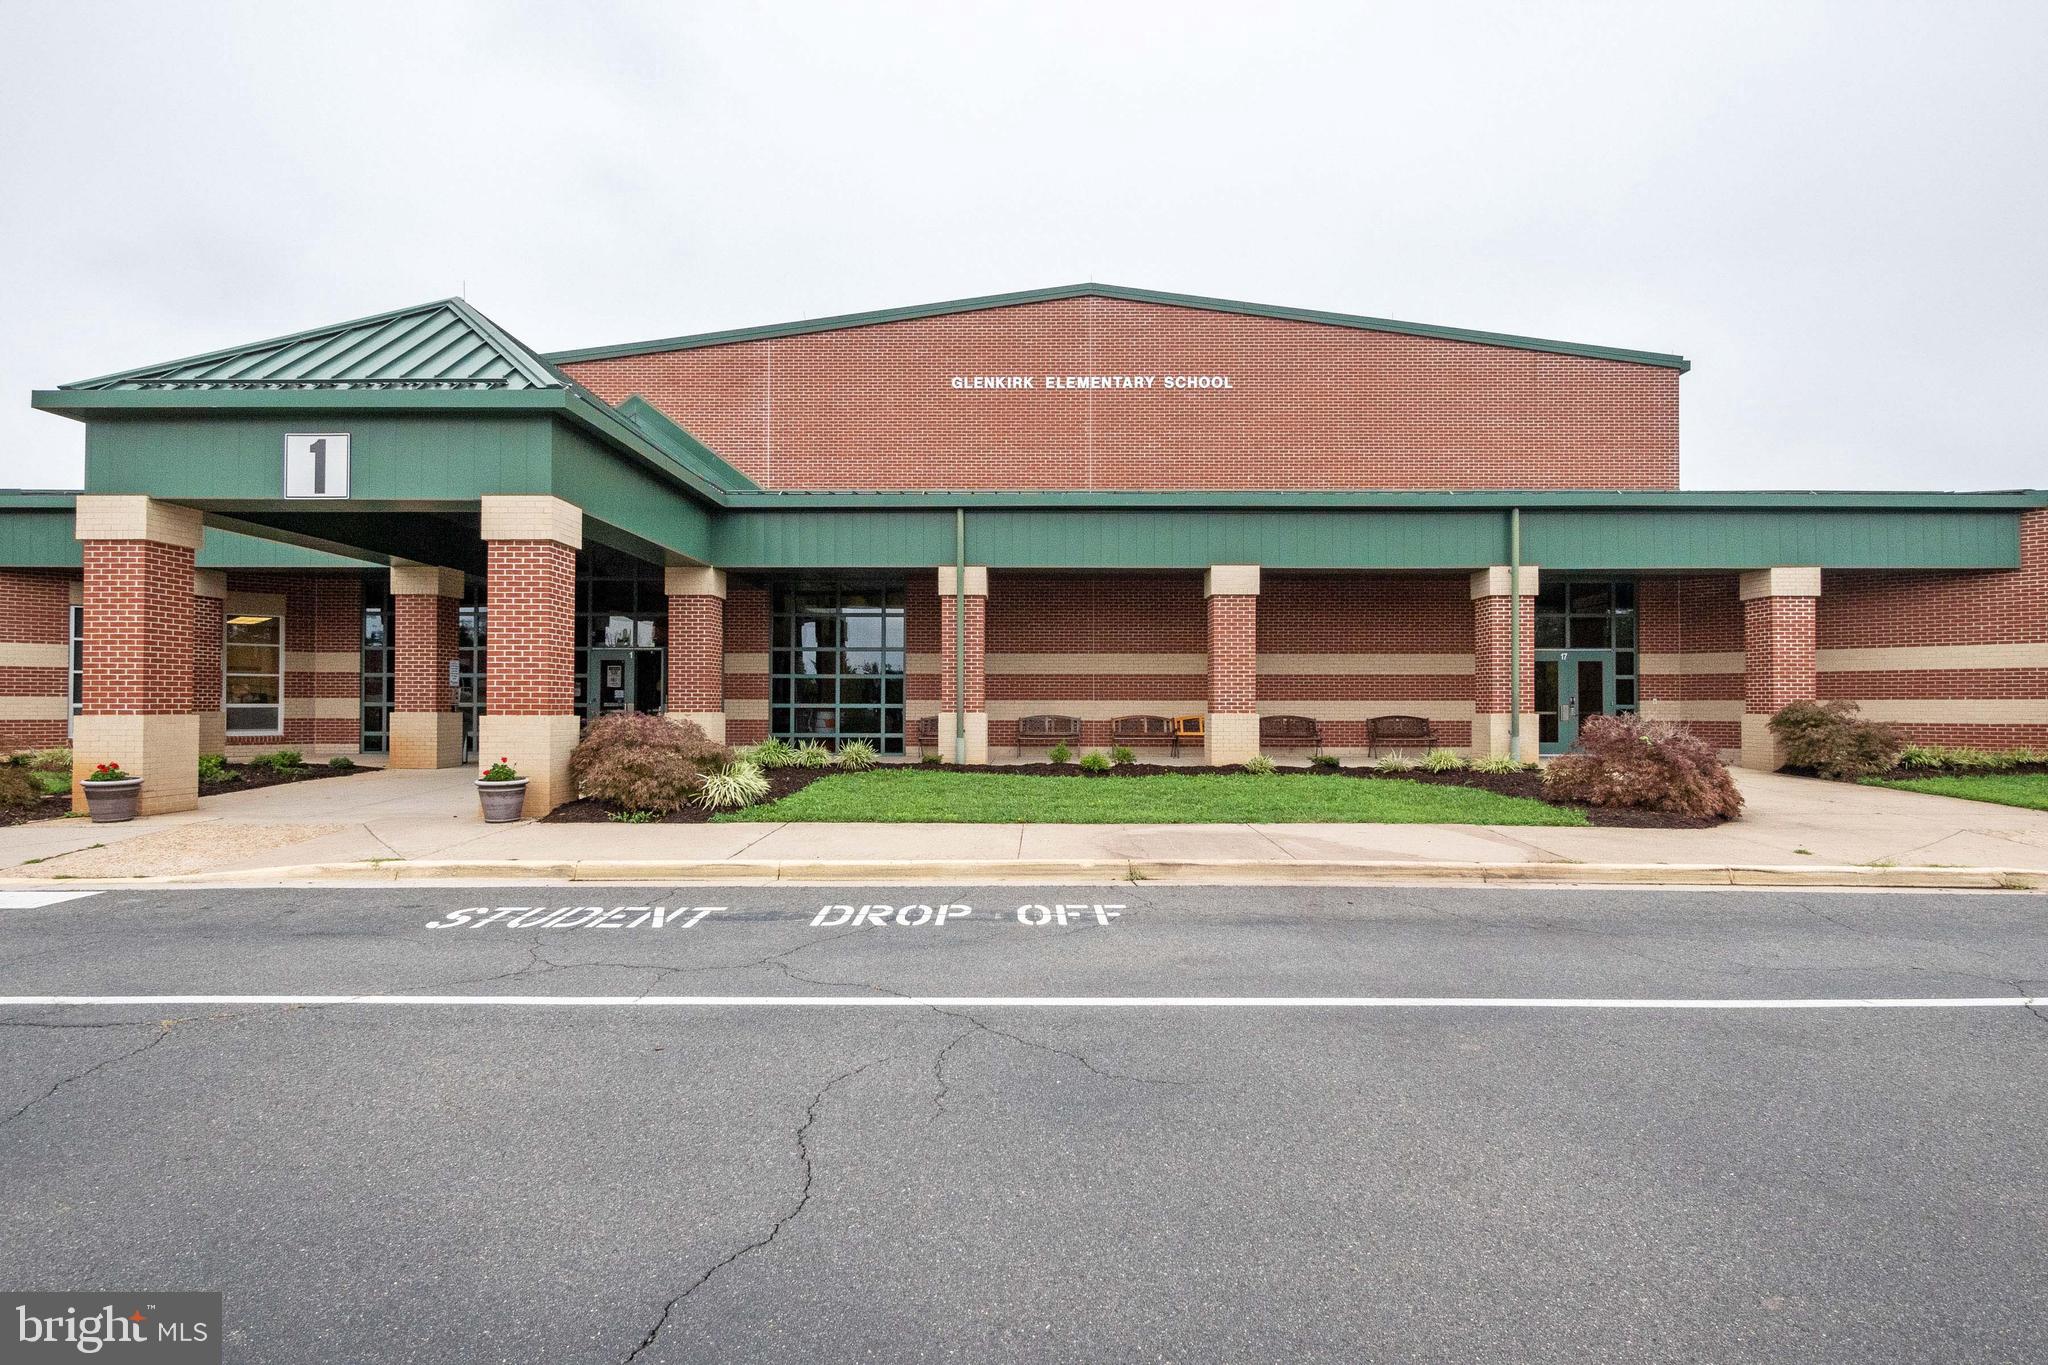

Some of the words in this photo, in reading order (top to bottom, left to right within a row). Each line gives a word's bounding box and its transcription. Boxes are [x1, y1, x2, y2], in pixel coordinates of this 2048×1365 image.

[951, 376, 1034, 389] GLENKIRK
[1045, 376, 1155, 389] ELEMENTARY
[1164, 376, 1233, 389] SCHOOL
[309, 438, 327, 494] 1
[1560, 652, 1568, 661] 17
[425, 906, 728, 929] STUDENT
[809, 904, 972, 927] DROP
[1016, 904, 1126, 927] OFF
